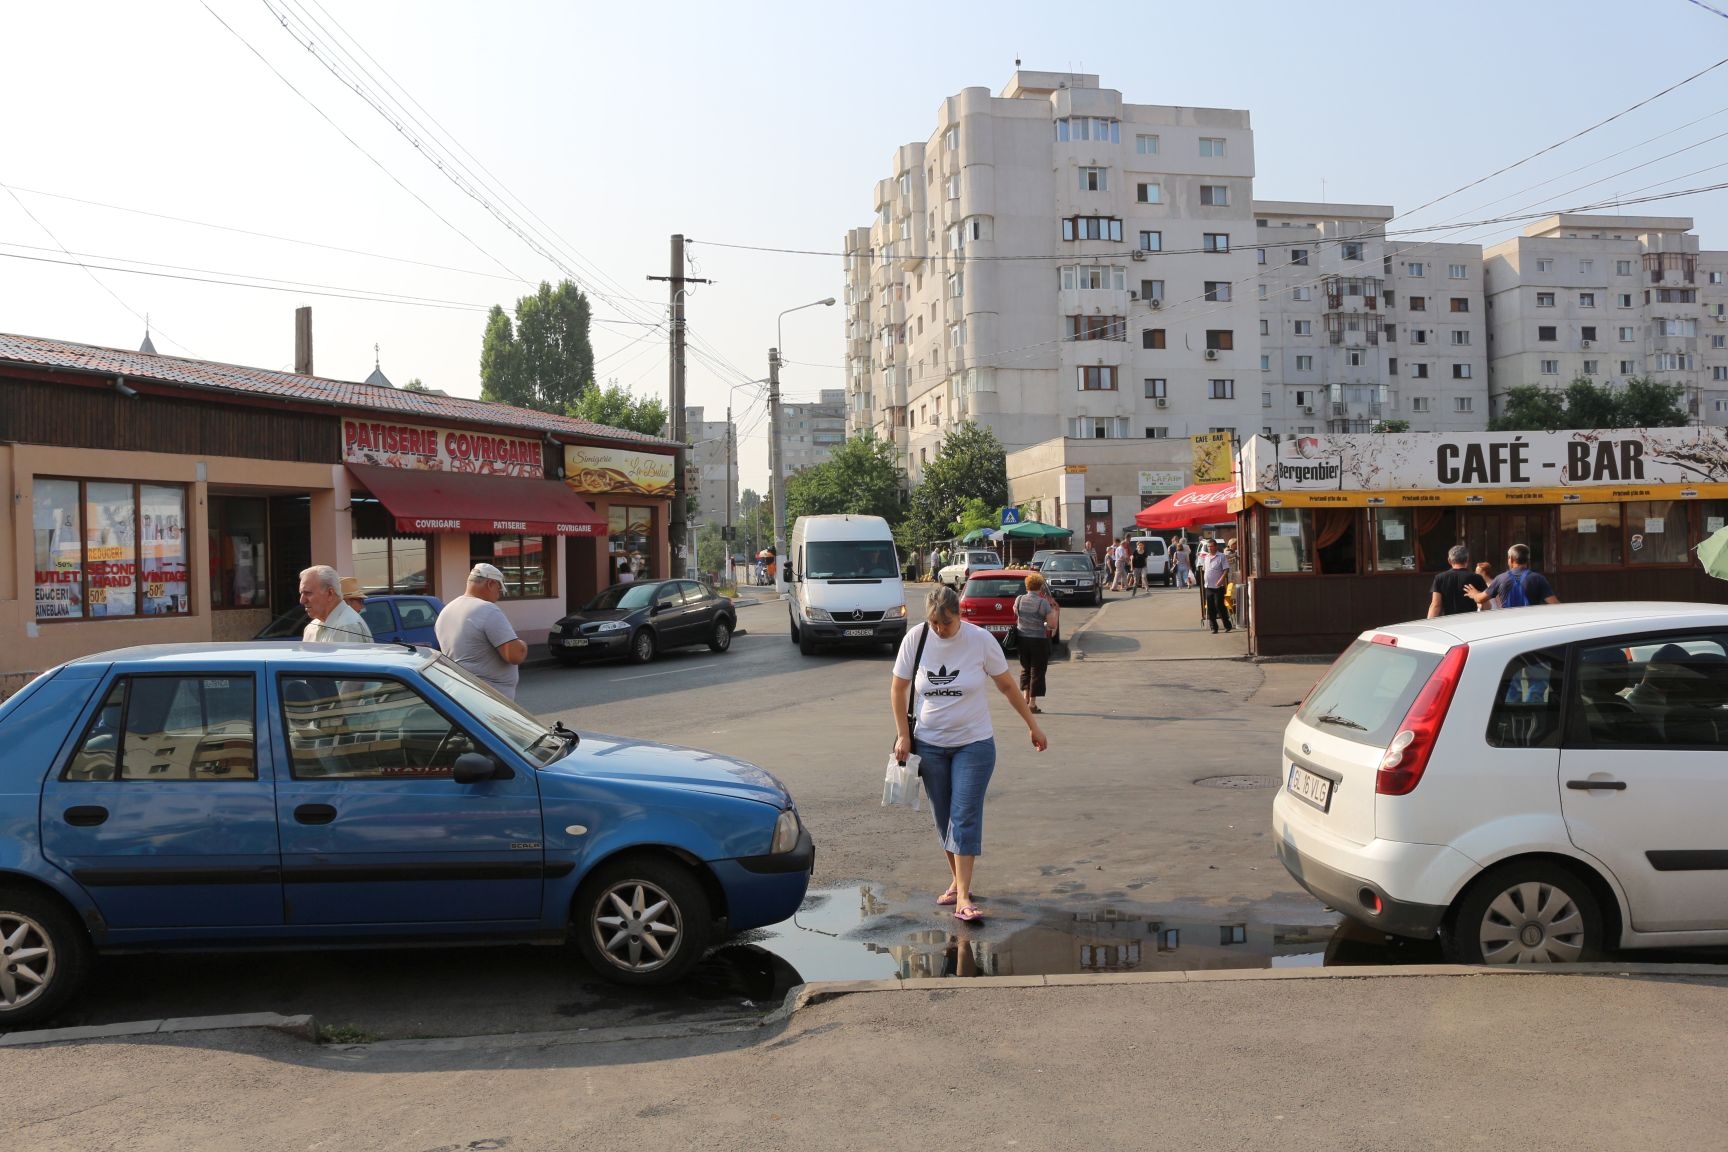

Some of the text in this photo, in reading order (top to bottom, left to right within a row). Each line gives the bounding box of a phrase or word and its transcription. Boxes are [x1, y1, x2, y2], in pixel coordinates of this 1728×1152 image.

[345, 421, 543, 466] PATISERIE COVRIGARIE
[1436, 436, 1530, 484] CAFÉ
[1567, 440, 1645, 482] BAR
[1279, 461, 1339, 483] Bergenbier
[415, 520, 461, 529] COVRIGARIE
[493, 521, 527, 530] PATISERIE
[556, 524, 592, 532] COVRIGARIE
[87, 563, 137, 575] SECOND
[92, 575, 132, 587] HAND
[924, 689, 963, 697] adidas
[1294, 769, 1327, 802] GL 16 VLG
